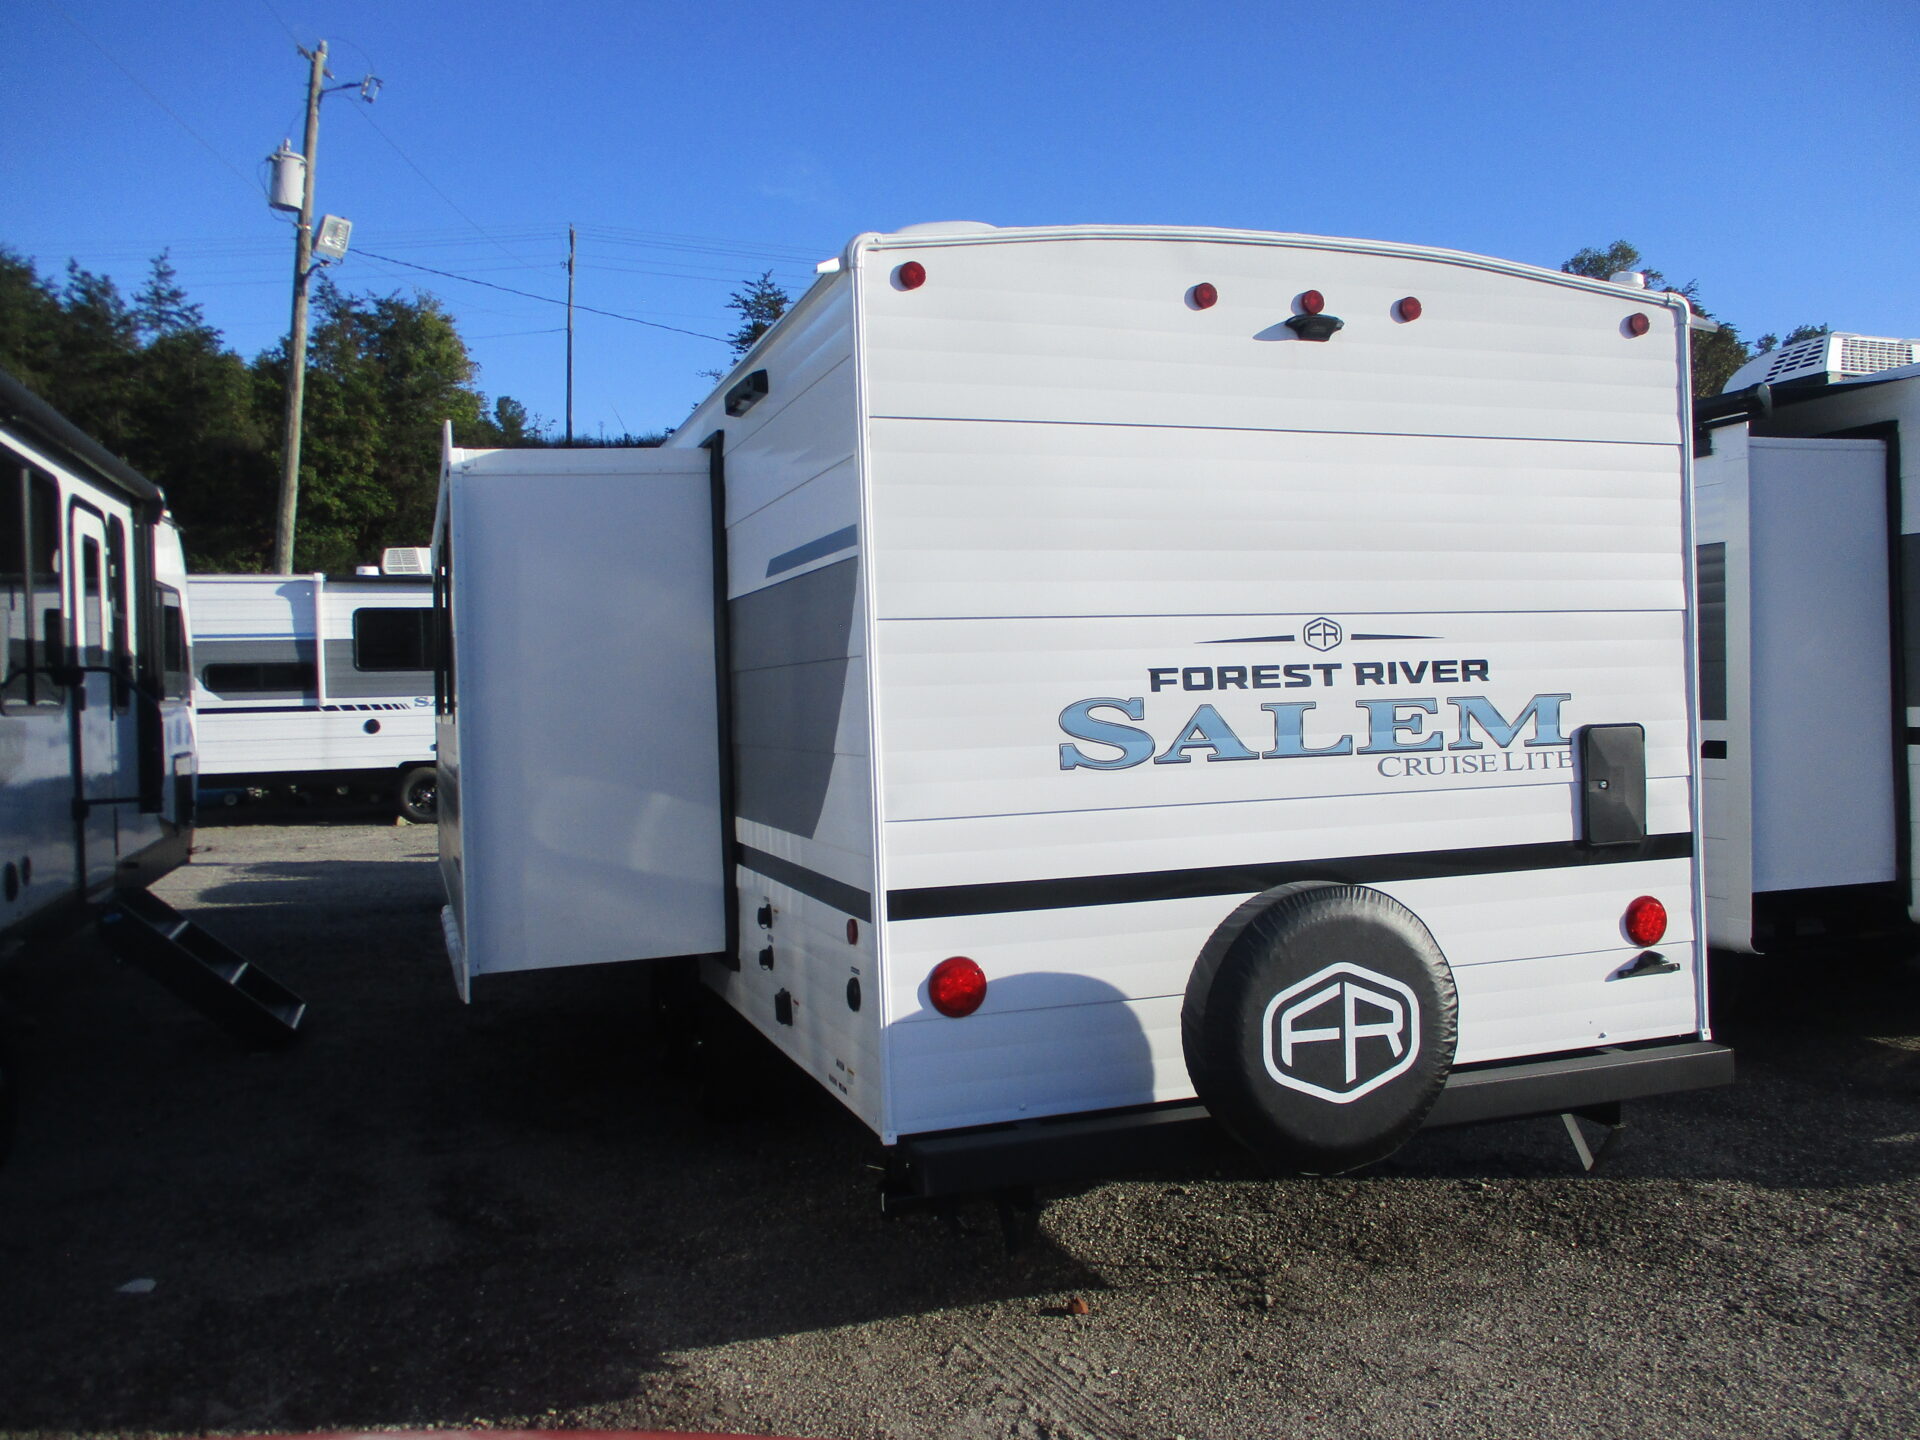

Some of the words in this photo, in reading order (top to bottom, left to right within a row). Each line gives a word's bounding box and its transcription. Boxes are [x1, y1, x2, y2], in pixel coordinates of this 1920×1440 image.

[1147, 662, 1342, 693] FOREST
[1352, 659, 1490, 686] RIVER
[1059, 693, 1573, 770] SALEM
[1281, 981, 1403, 1084] FR
